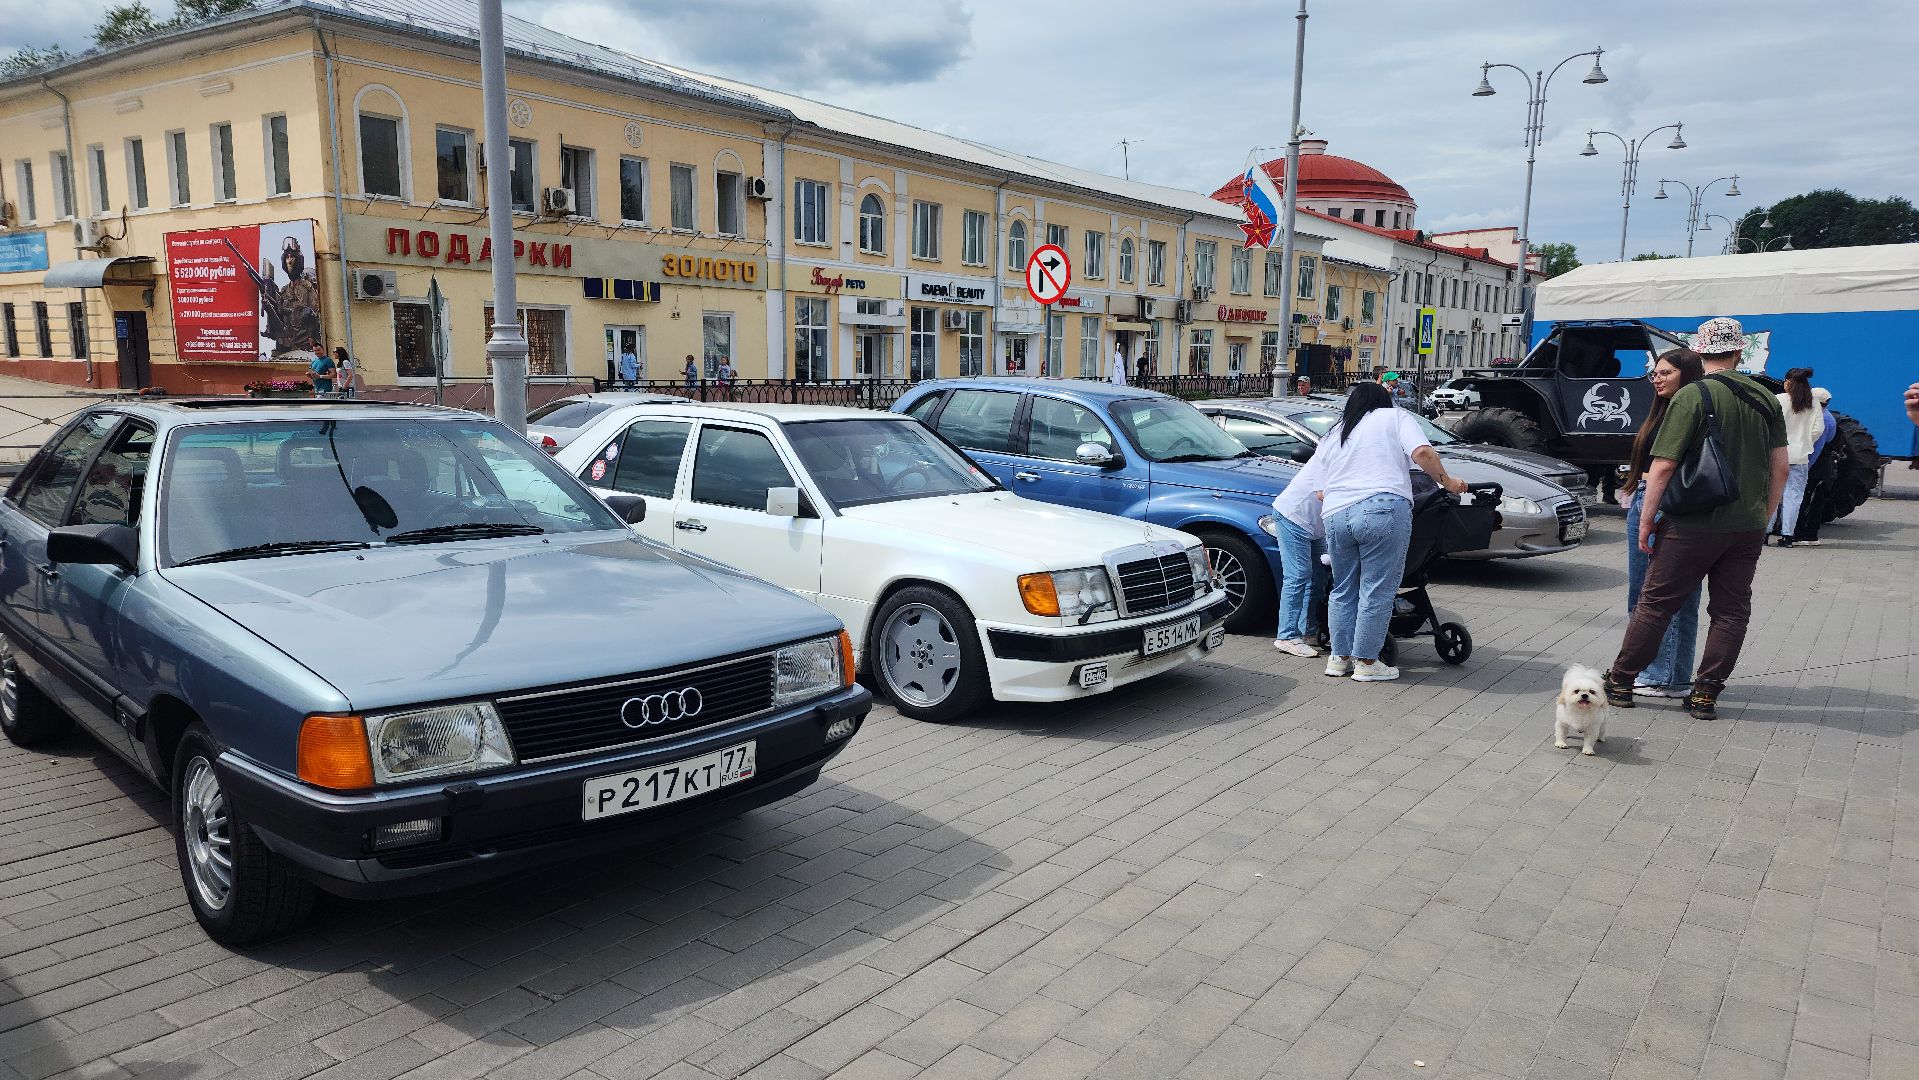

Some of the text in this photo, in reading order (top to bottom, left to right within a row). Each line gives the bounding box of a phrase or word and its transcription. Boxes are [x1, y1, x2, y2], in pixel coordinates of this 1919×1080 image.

[181, 267, 194, 279] 520
[194, 266, 209, 278] 000
[210, 265, 236, 280] рублей
[662, 253, 758, 282] ЗОЛОТО
[957, 286, 985, 299] BEAUTY
[1185, 620, 1198, 640] МК
[1086, 670, 1106, 682] Hella
[599, 747, 747, 812] Р217КТ 77
[722, 771, 739, 782] RUS
